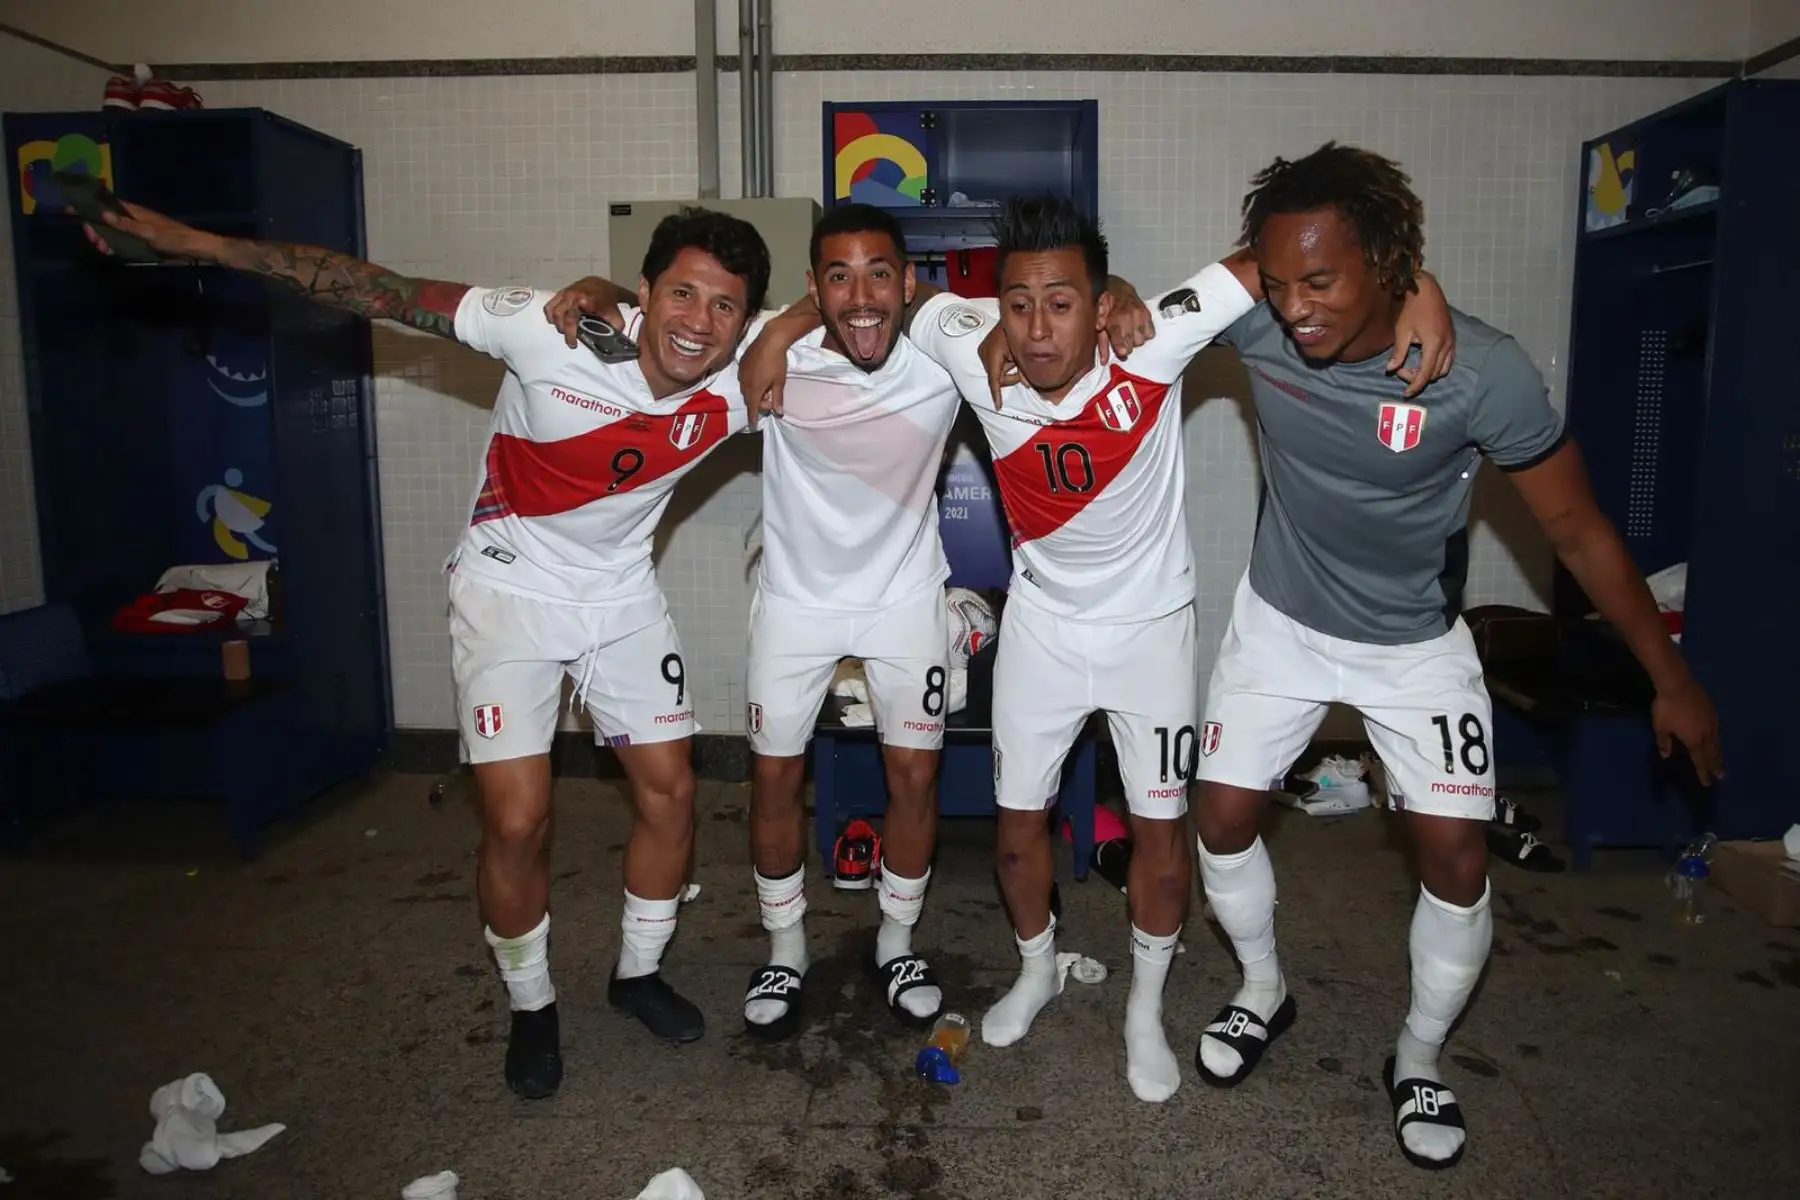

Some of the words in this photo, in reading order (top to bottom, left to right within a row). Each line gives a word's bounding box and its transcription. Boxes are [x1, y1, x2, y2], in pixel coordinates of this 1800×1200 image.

[550, 387, 622, 418] marathon
[607, 448, 644, 491] 9
[1034, 441, 1096, 495] 10
[944, 506, 969, 520] 2021
[660, 652, 685, 706] 9
[922, 665, 946, 717] 8
[1154, 724, 1196, 783] 10
[1431, 712, 1489, 776] 18
[1431, 783, 1494, 797] marathon
[759, 971, 789, 994] 22
[892, 959, 924, 985] 22
[1222, 1010, 1250, 1038] 18
[1412, 1085, 1440, 1116] 18
